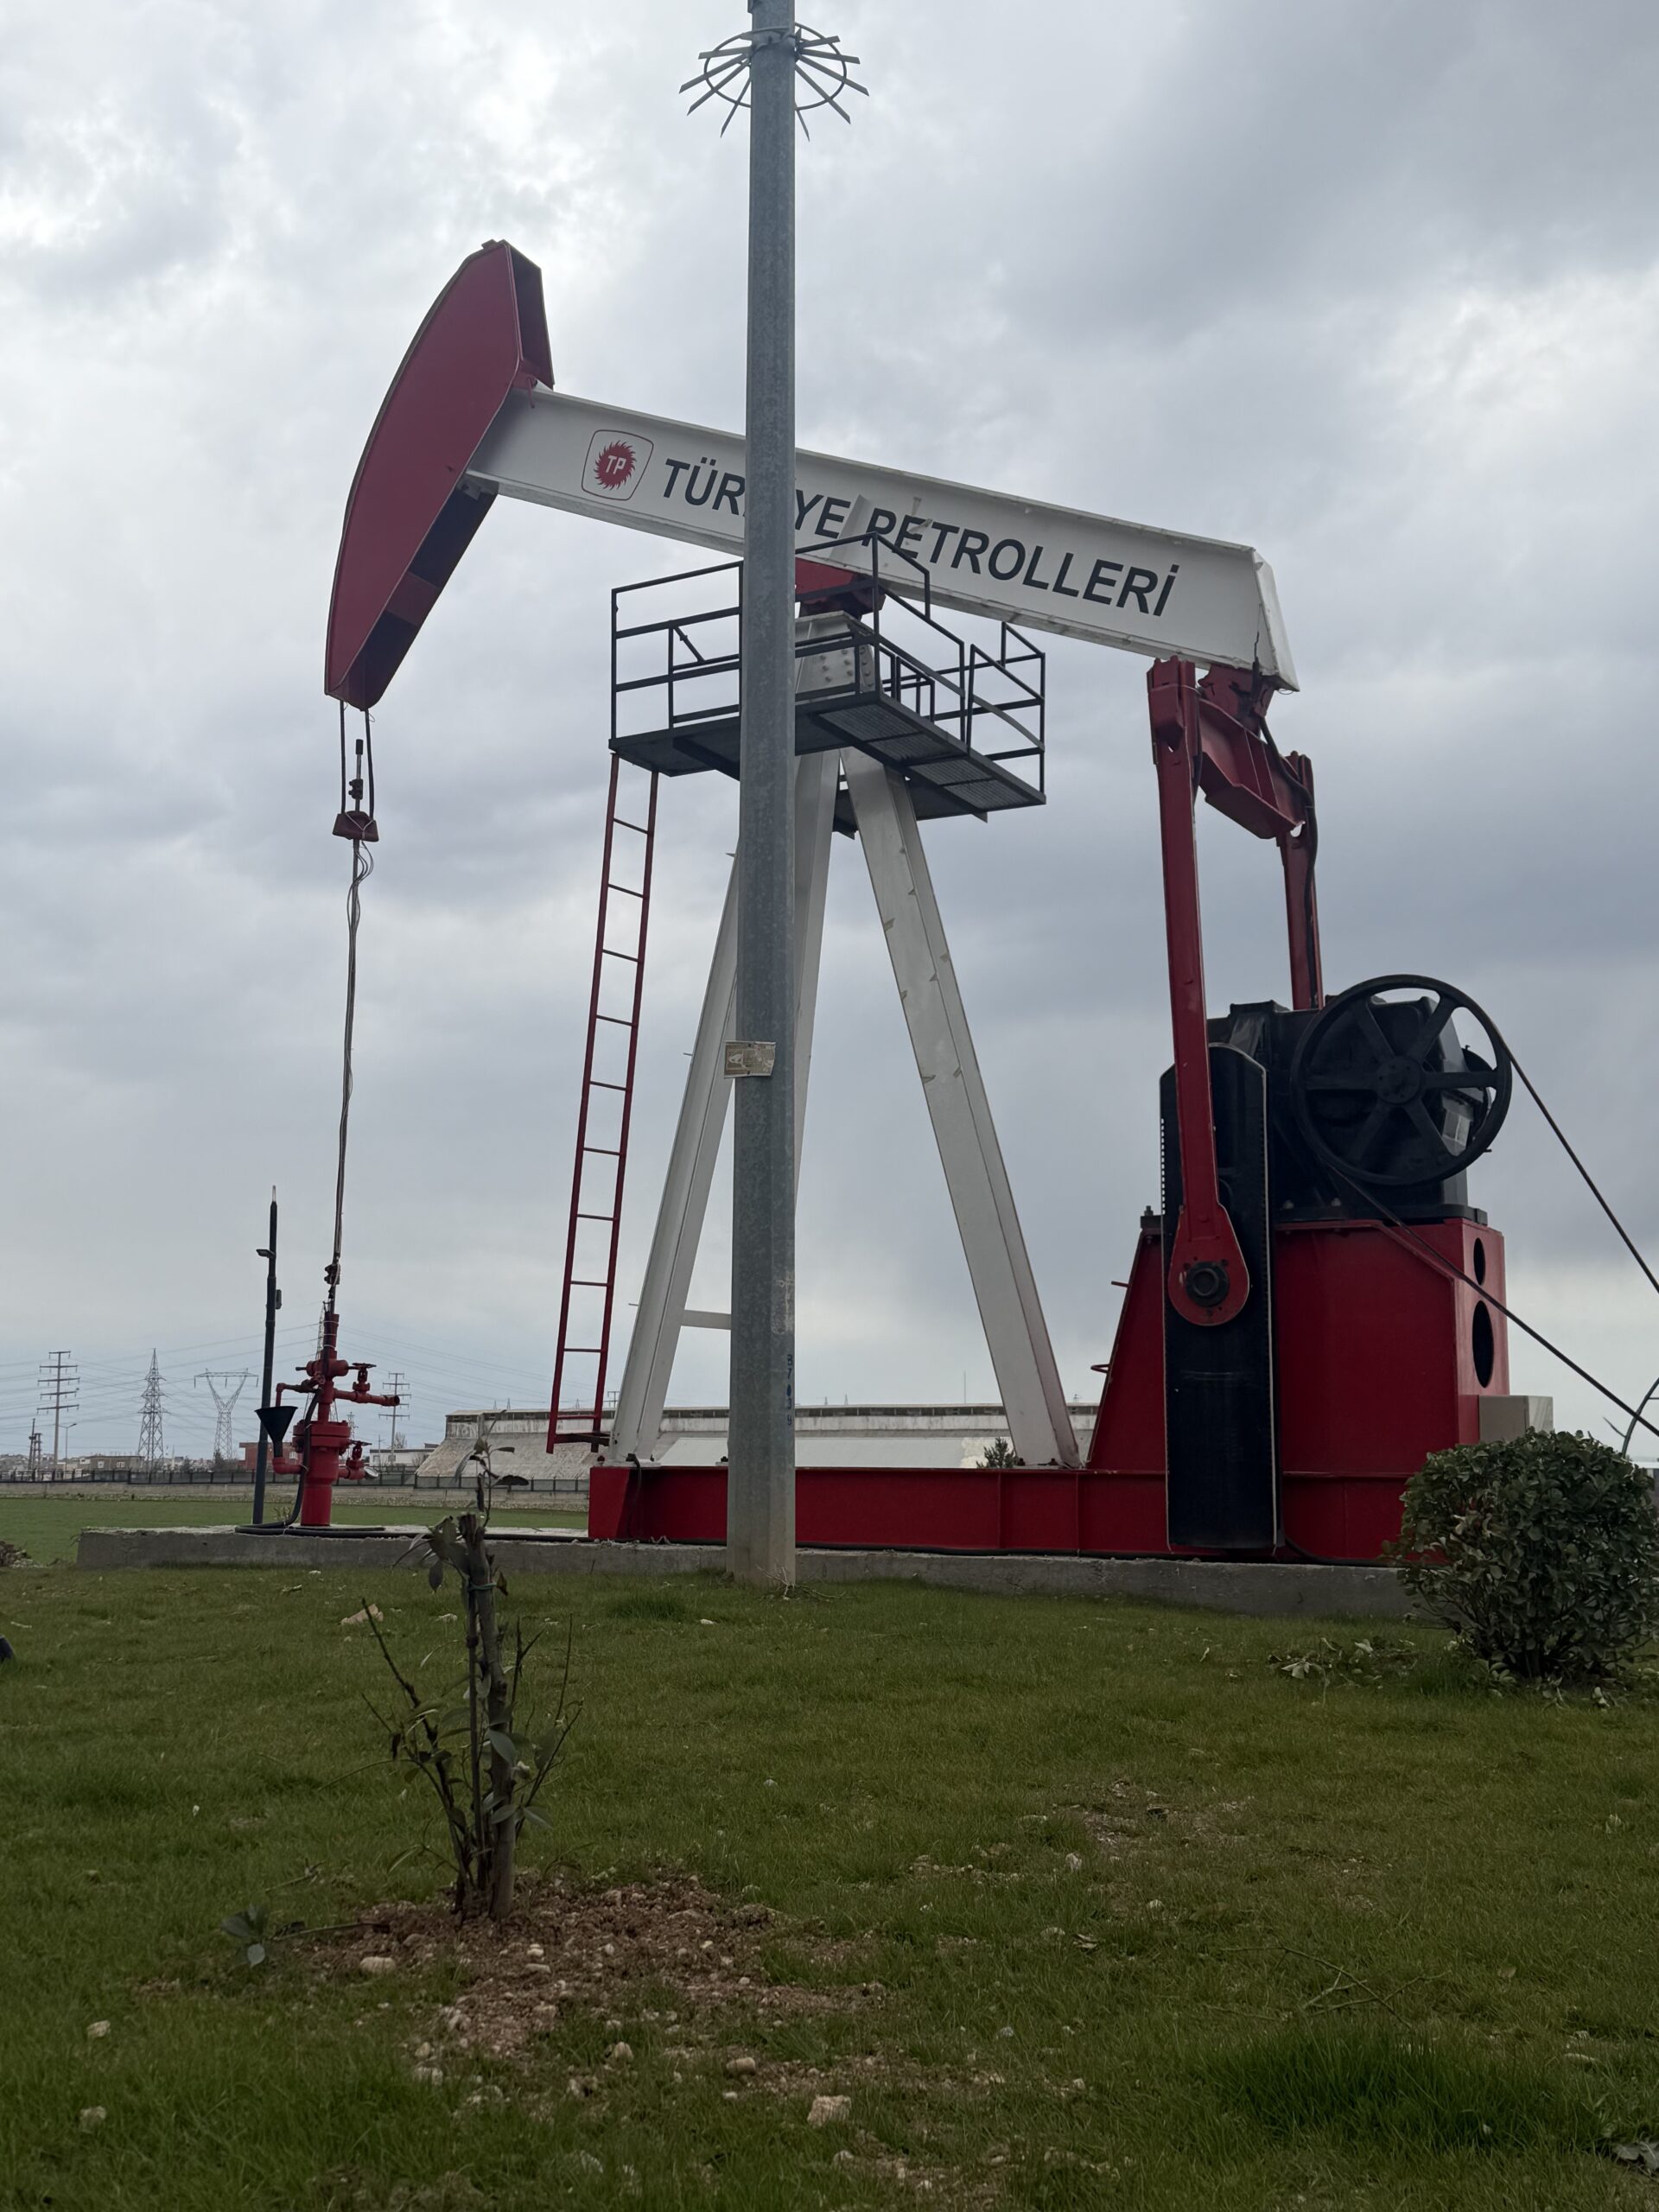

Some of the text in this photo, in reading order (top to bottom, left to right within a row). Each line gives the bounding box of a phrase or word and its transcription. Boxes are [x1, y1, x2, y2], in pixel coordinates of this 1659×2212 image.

[606, 454, 627, 474] TP
[663, 456, 1180, 617] TÜRYE PETROLLERİ
